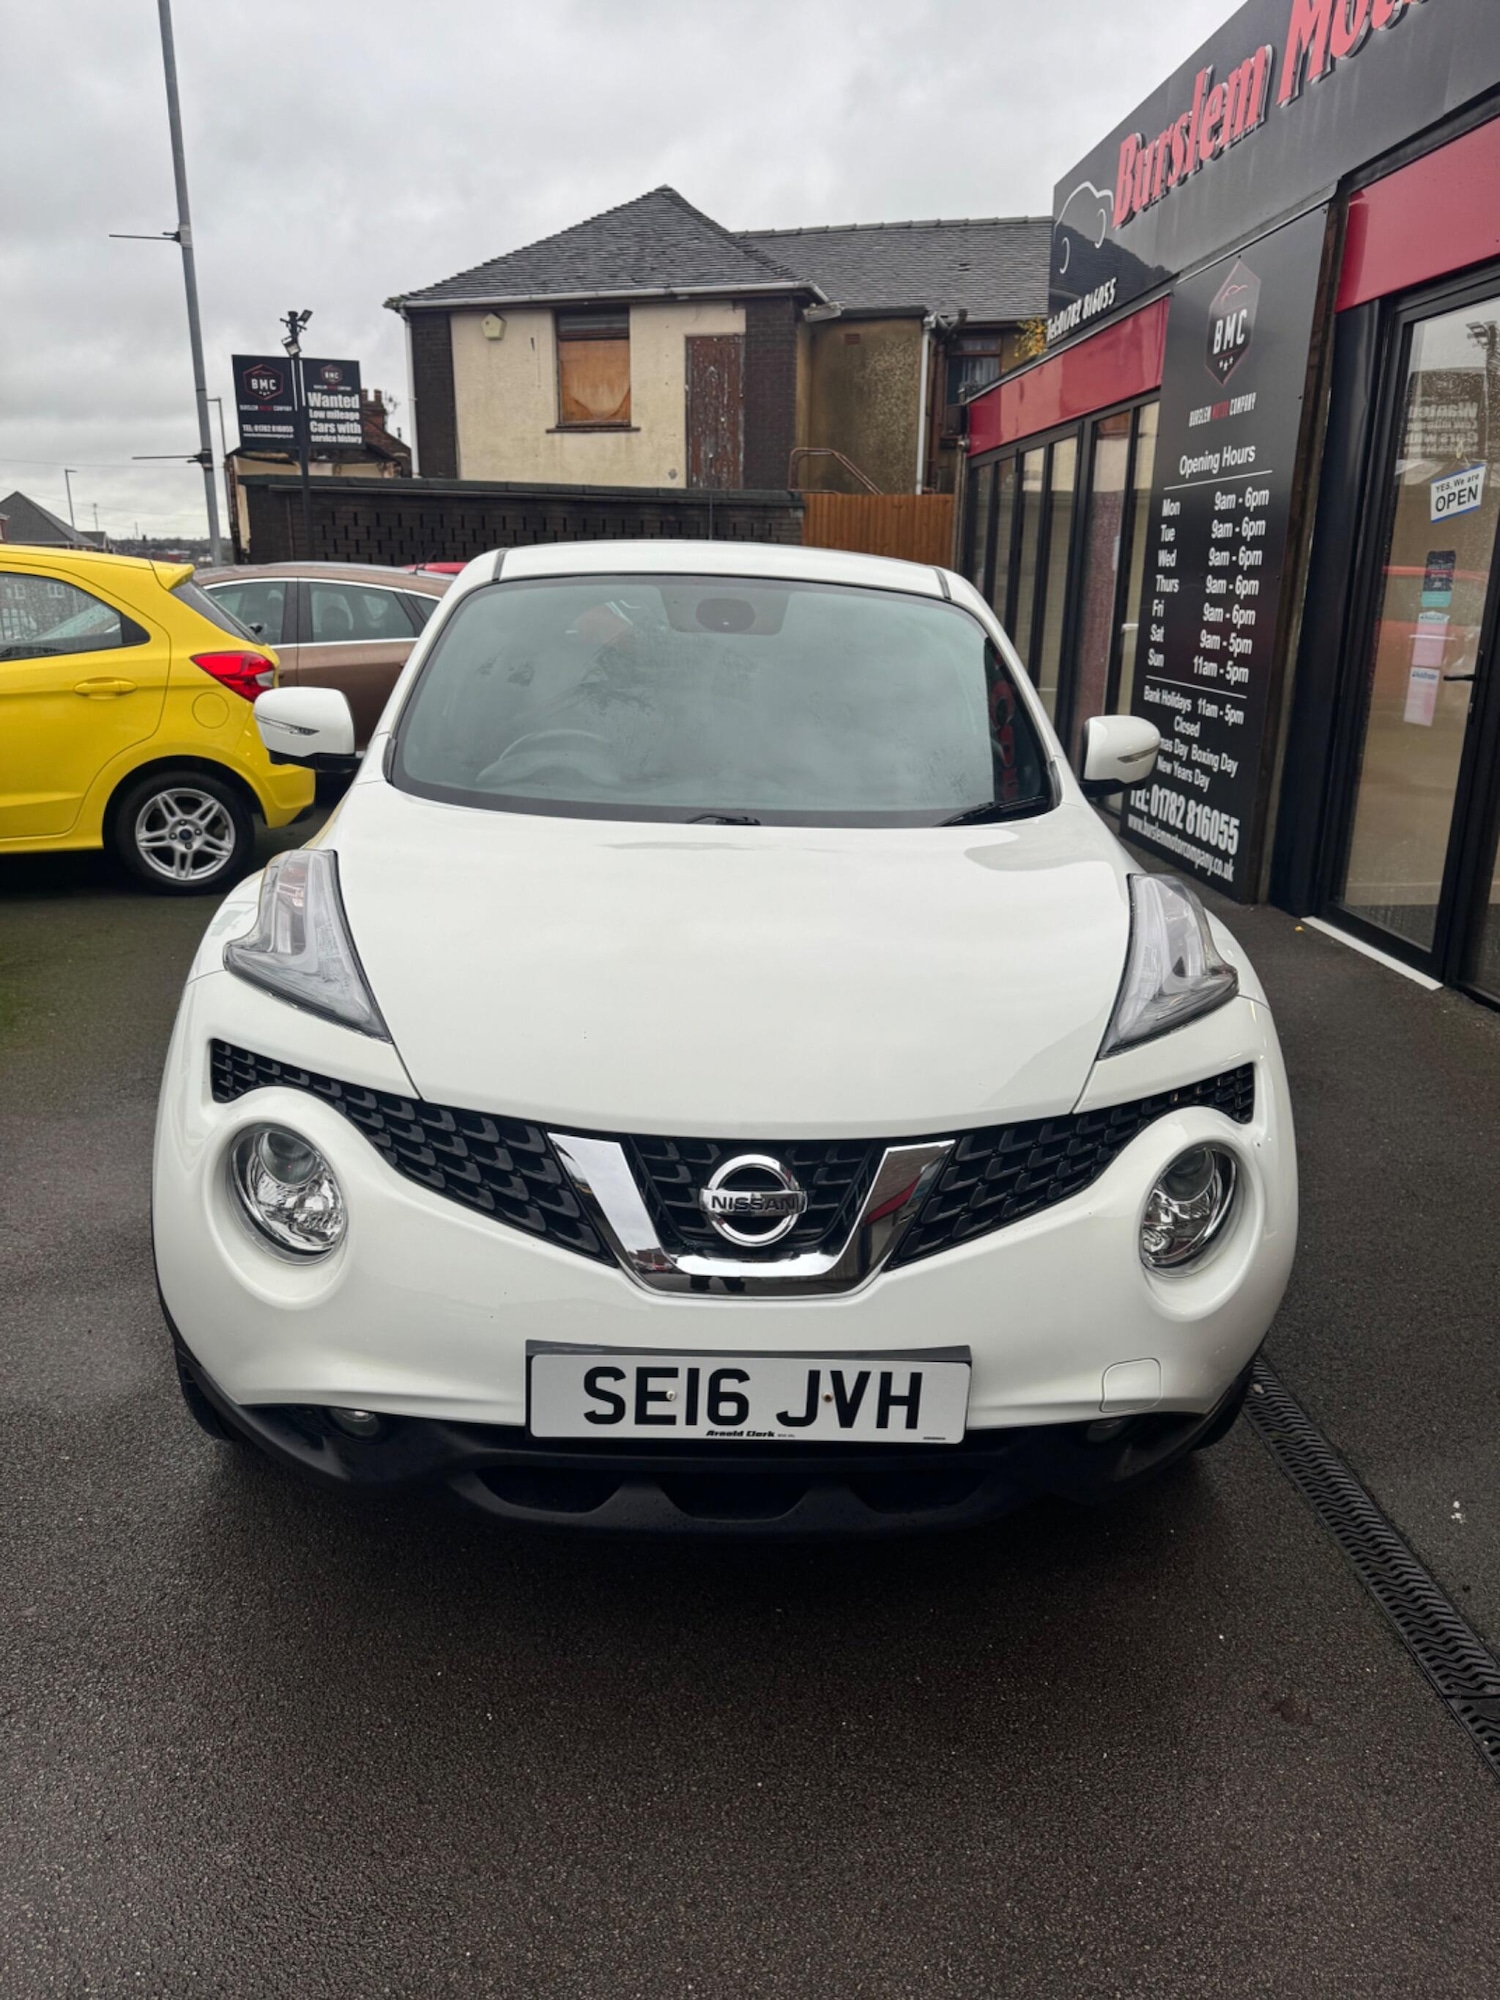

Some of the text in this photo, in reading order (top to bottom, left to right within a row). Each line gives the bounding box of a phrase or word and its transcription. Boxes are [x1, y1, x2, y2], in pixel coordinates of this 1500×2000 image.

[1112, 45, 1270, 229] Burslem
[1213, 308, 1247, 355] BMC
[251, 378, 276, 390] BMC
[307, 392, 360, 408] Wanted
[309, 409, 360, 420] Low mileage
[310, 420, 362, 434] Cars with
[1179, 445, 1256, 478] Opening Hours
[1454, 476, 1465, 487] We
[1467, 474, 1480, 484] are
[1161, 498, 1181, 517] Mon
[1213, 491, 1236, 511] 9am
[1244, 486, 1269, 512] 6pm
[1436, 484, 1478, 512] OPEN
[1160, 524, 1176, 542] Tue
[1211, 519, 1233, 539] 9am
[1241, 516, 1266, 542] 6pm
[1157, 548, 1177, 567] Wed
[1208, 547, 1230, 566] 9am
[1238, 545, 1263, 571] 6pm
[1155, 574, 1179, 593] Thurs
[1205, 574, 1227, 594] 9am
[1235, 574, 1260, 600] 6pm
[1152, 599, 1164, 617] Fri
[1202, 602, 1223, 622] 9am
[1232, 604, 1256, 629] 6pm
[1150, 623, 1164, 642] Sat
[1200, 629, 1220, 650] 9am
[1228, 632, 1252, 658] 5pm
[1147, 648, 1164, 667] Sun
[1193, 655, 1218, 678] 11am
[1225, 660, 1249, 686] 5pm
[1144, 685, 1160, 703] Bank
[1160, 689, 1192, 714] Holidays
[1198, 698, 1218, 718] 11am
[1224, 704, 1244, 726] 5pm
[1174, 716, 1200, 737] Closed
[1174, 738, 1189, 761] Day
[1191, 744, 1220, 772] Boxing
[1220, 752, 1238, 778] Day
[1157, 755, 1210, 792] New Years Day
[1150, 784, 1186, 830] 01782
[1186, 799, 1240, 855] 816055
[711, 1195, 795, 1211] NISSAN
[583, 1366, 923, 1430] SE16 JVH
